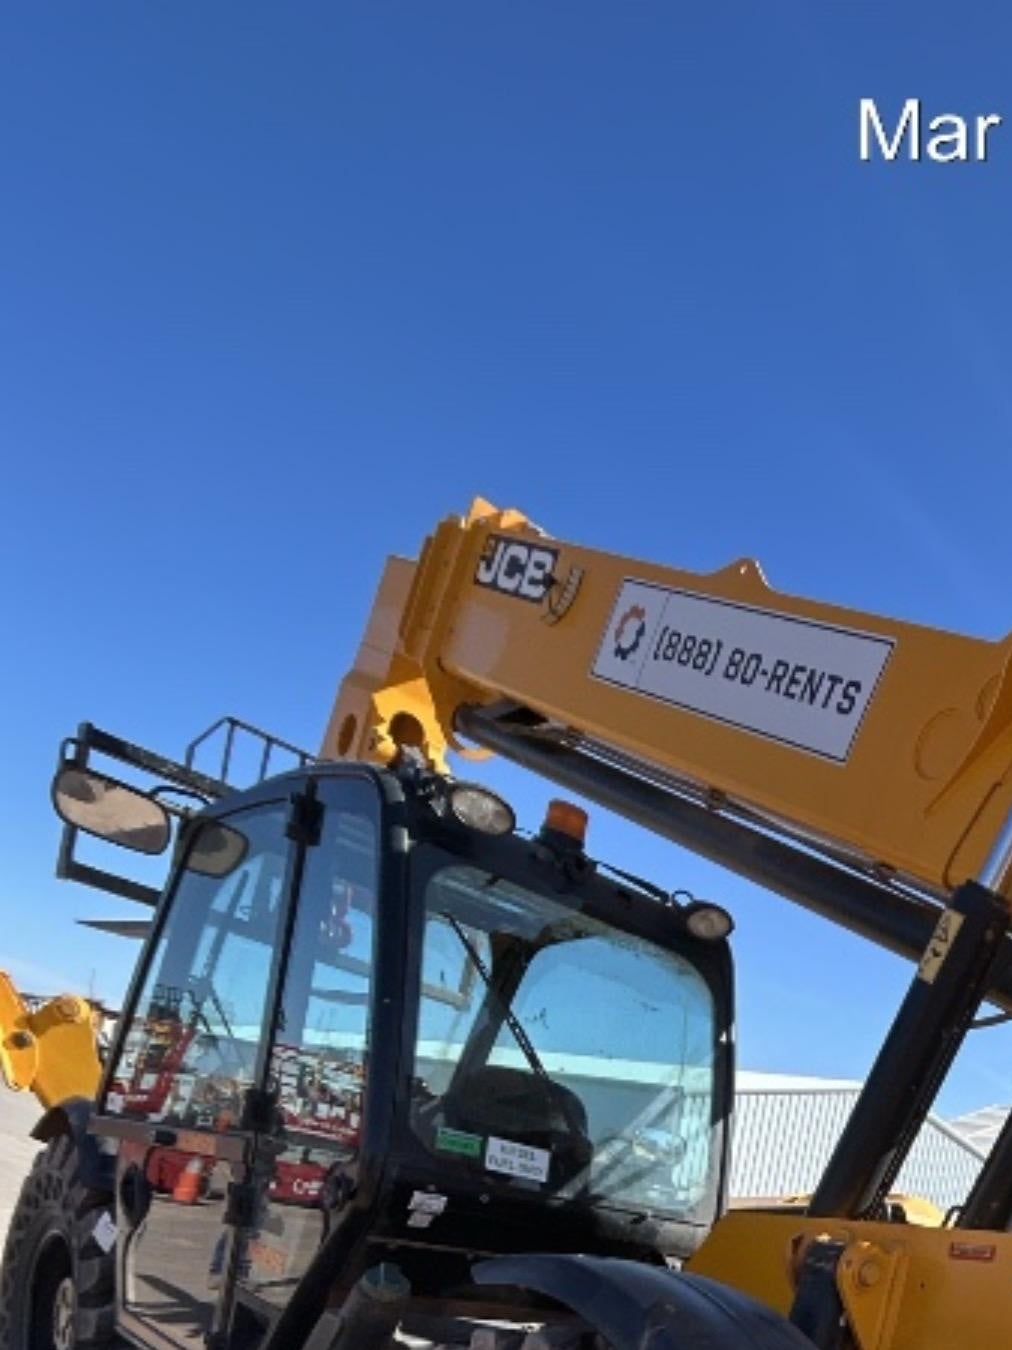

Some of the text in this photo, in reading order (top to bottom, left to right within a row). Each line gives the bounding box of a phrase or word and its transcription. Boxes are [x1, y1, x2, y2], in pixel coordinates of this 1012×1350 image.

[476, 538, 556, 599] JCB
[653, 624, 863, 716] (888) 80-RENTS
